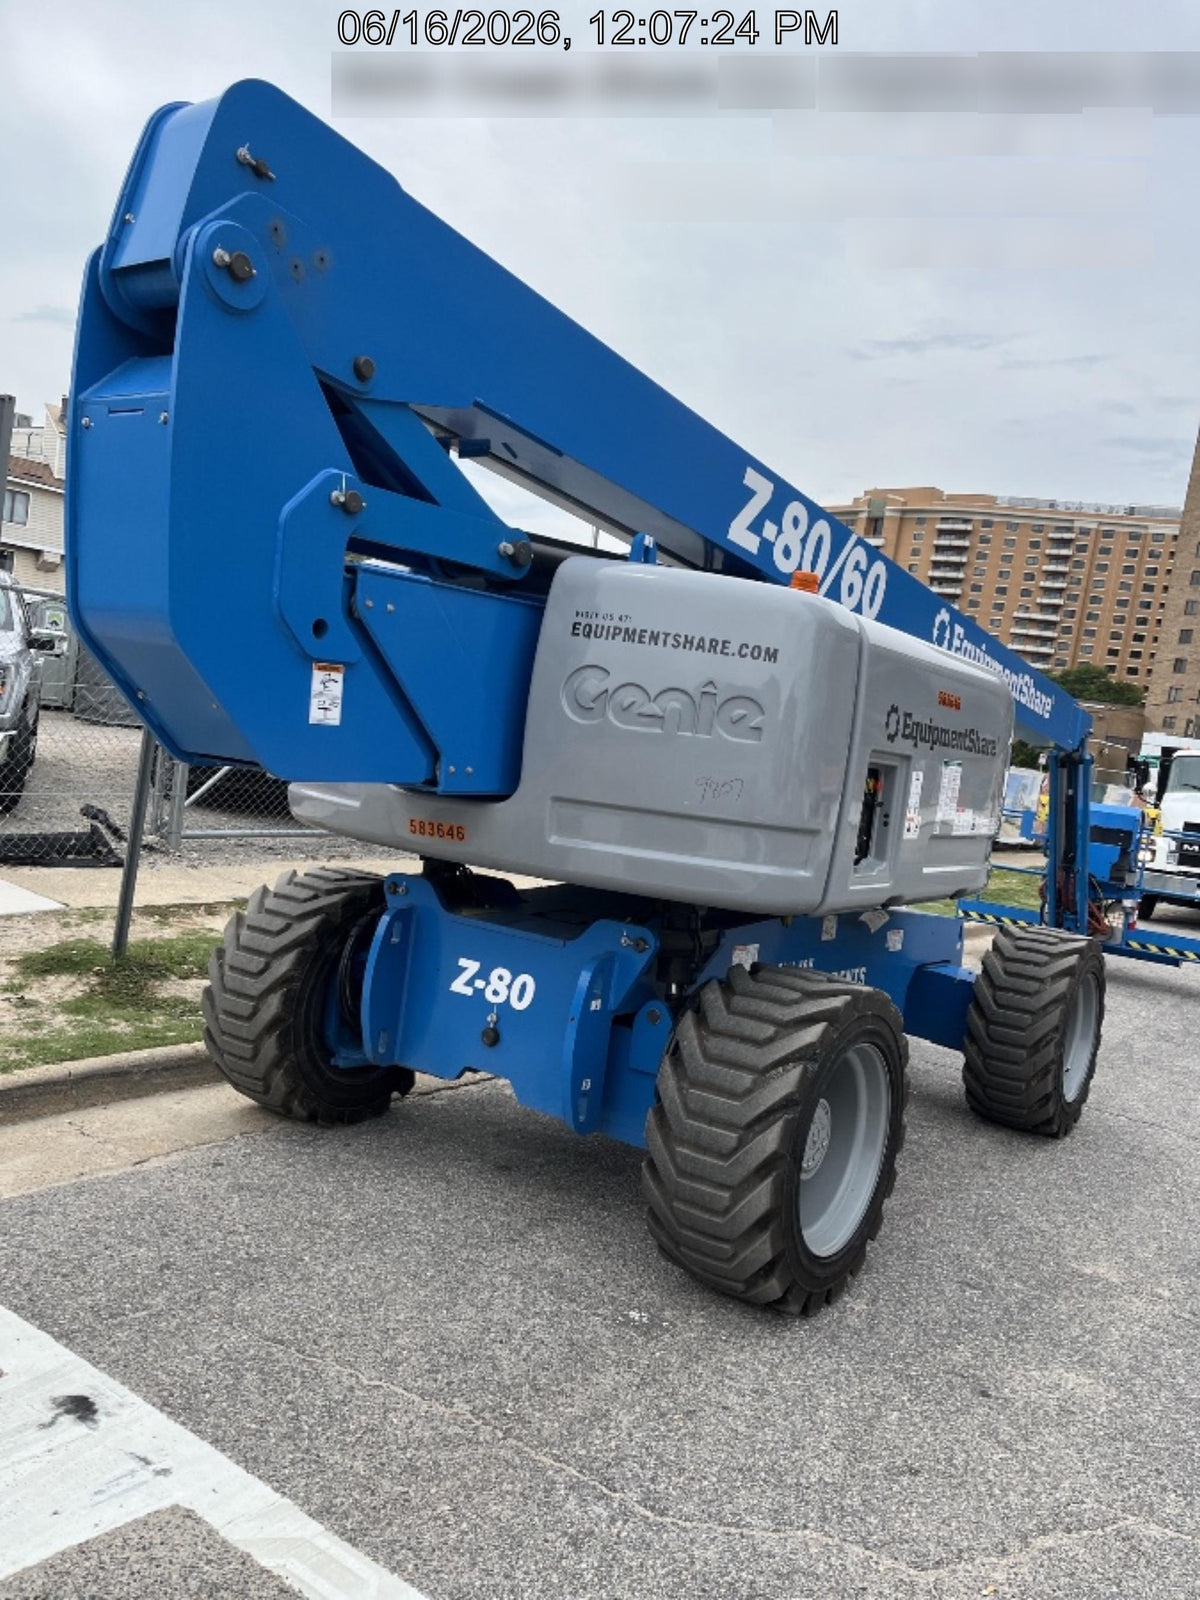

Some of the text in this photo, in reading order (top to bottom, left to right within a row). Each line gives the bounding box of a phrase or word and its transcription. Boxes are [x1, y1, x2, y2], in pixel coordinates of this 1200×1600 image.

[727, 466, 887, 620] Z-80/60
[571, 621, 779, 664] EQUIPMENTSHARE.COM
[560, 664, 766, 744] Genie
[901, 712, 998, 757] EquipmentShare
[408, 818, 465, 841] 583646
[449, 957, 536, 1011] Z-80
